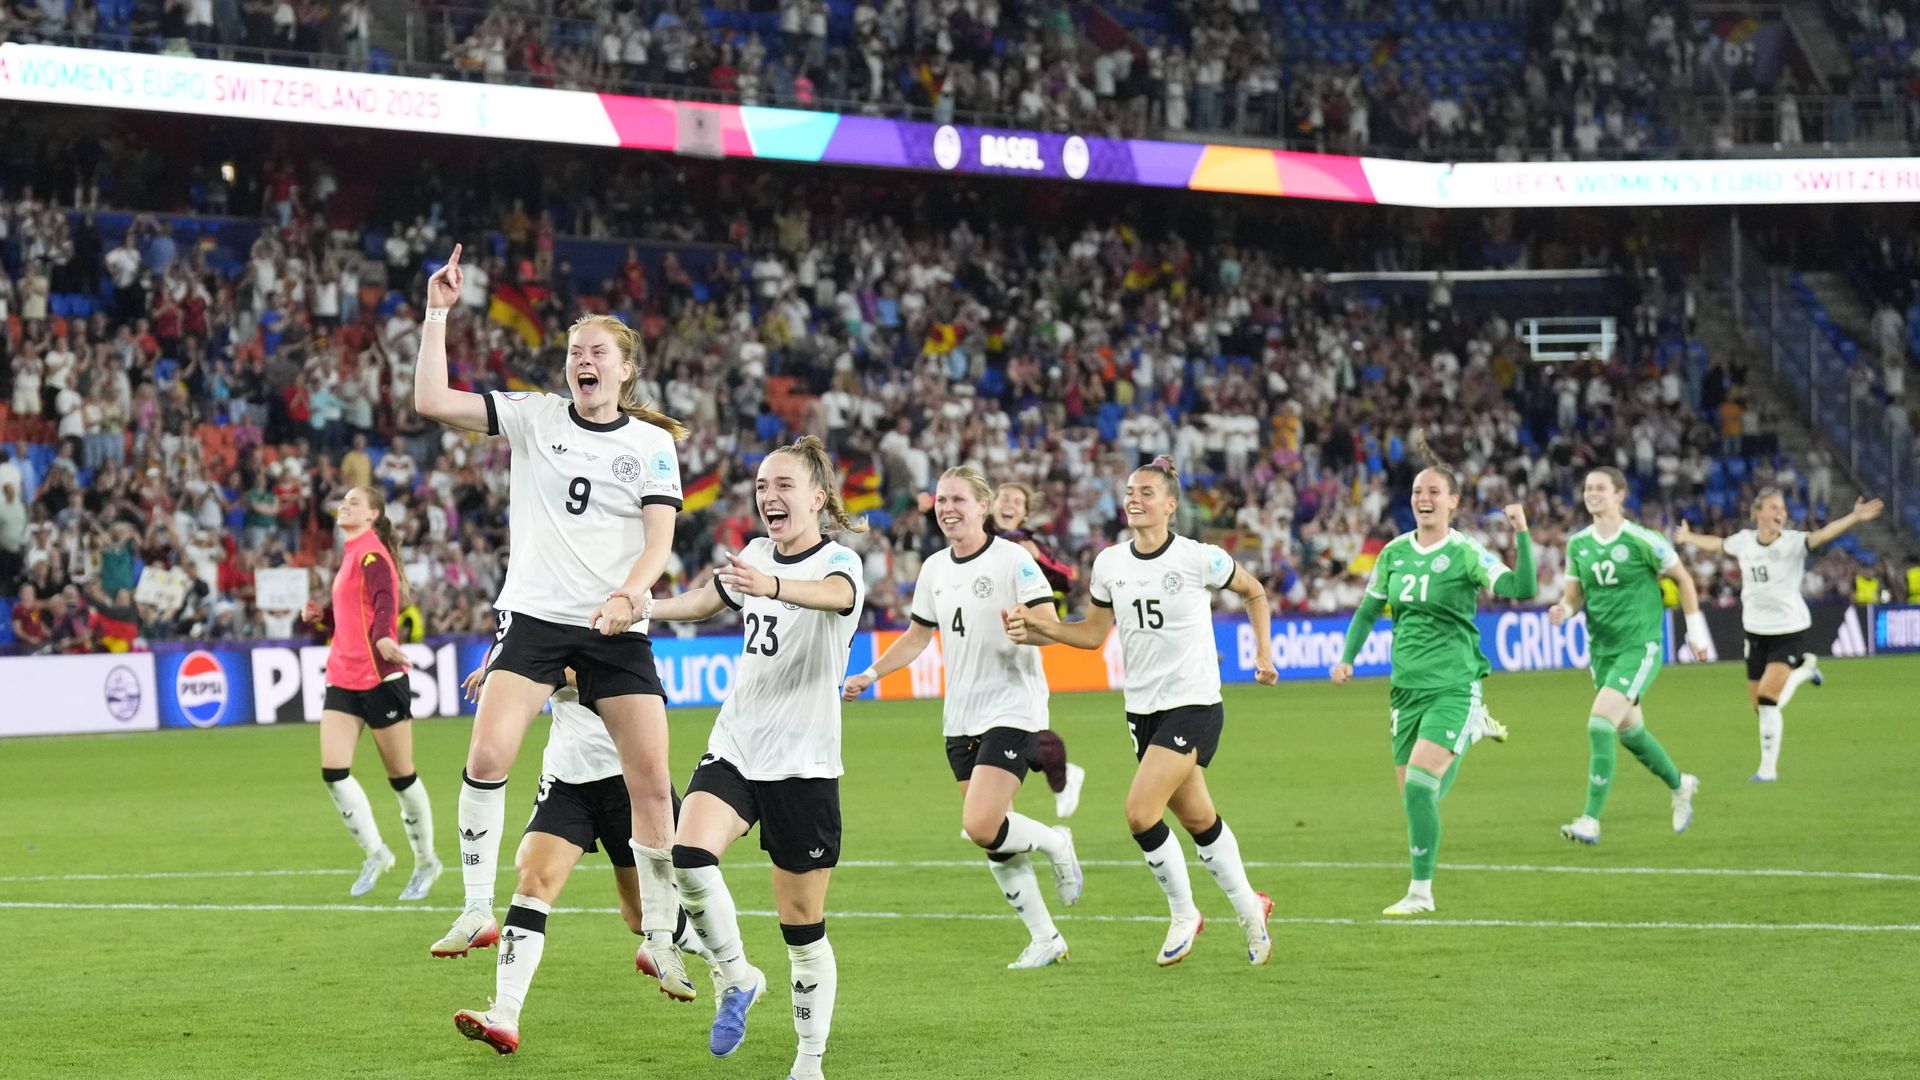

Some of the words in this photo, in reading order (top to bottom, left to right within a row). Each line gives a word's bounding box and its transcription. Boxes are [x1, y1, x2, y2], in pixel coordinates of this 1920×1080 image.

[20, 58, 134, 95] WOMEN'S
[142, 68, 206, 100] EURO
[214, 74, 377, 114] SWITZERLAND
[385, 88, 441, 119] 2025
[980, 133, 1045, 171] BASEL
[1493, 173, 1566, 195] UEFA
[1574, 172, 1702, 194] WOMEN'S
[1711, 170, 1784, 193] EURO
[565, 476, 592, 516] 9
[1399, 573, 1430, 602] 21
[1591, 559, 1619, 587] 12
[951, 606, 966, 638] 4
[1131, 598, 1164, 630] 15
[745, 612, 779, 657] 23
[180, 681, 223, 696] PEPSI
